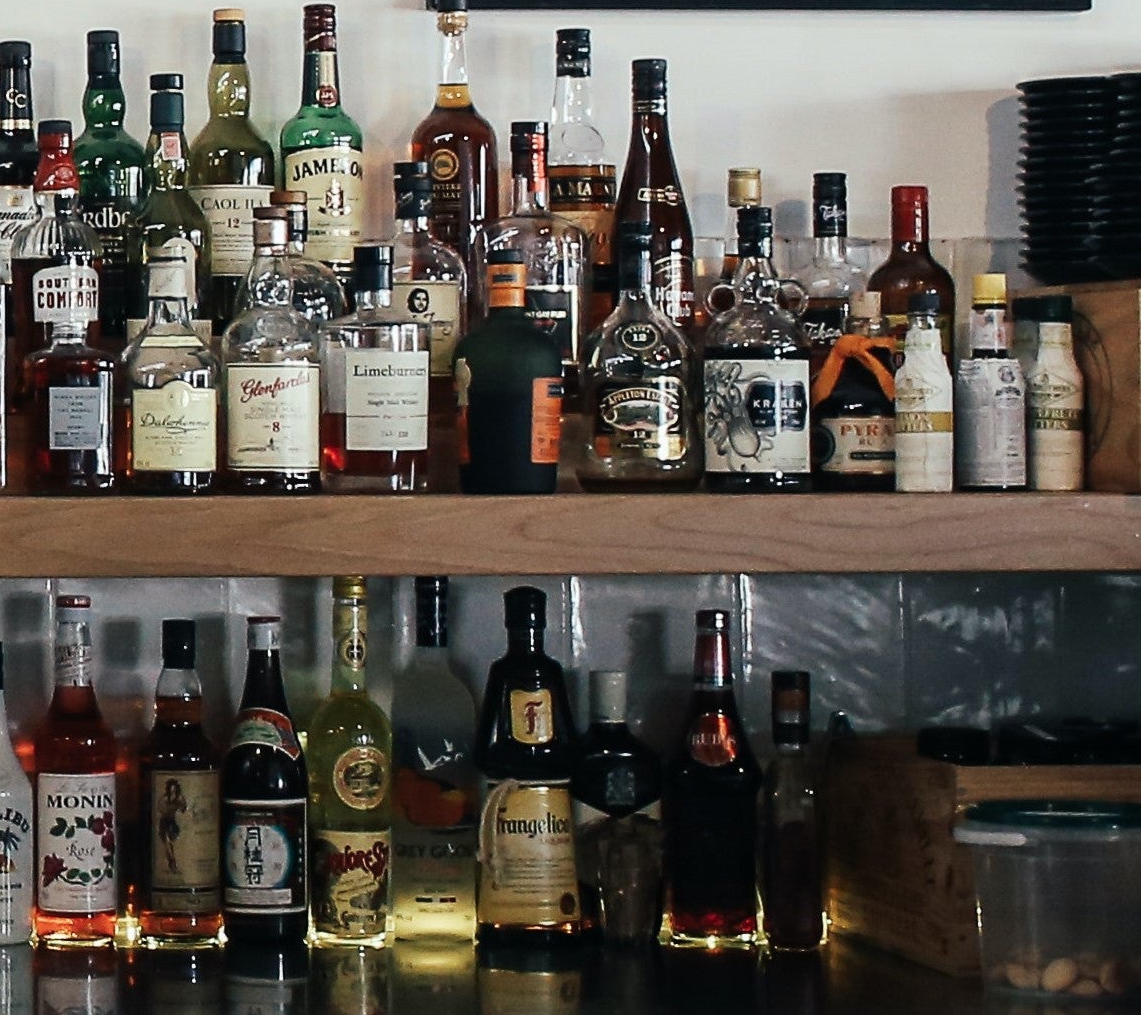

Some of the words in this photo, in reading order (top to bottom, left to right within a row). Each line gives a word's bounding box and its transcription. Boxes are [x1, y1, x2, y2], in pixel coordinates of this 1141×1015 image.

[201, 197, 241, 211] CAOL
[225, 218, 240, 229] 12
[271, 421, 281, 433] 8
[47, 793, 113, 809] MONIN
